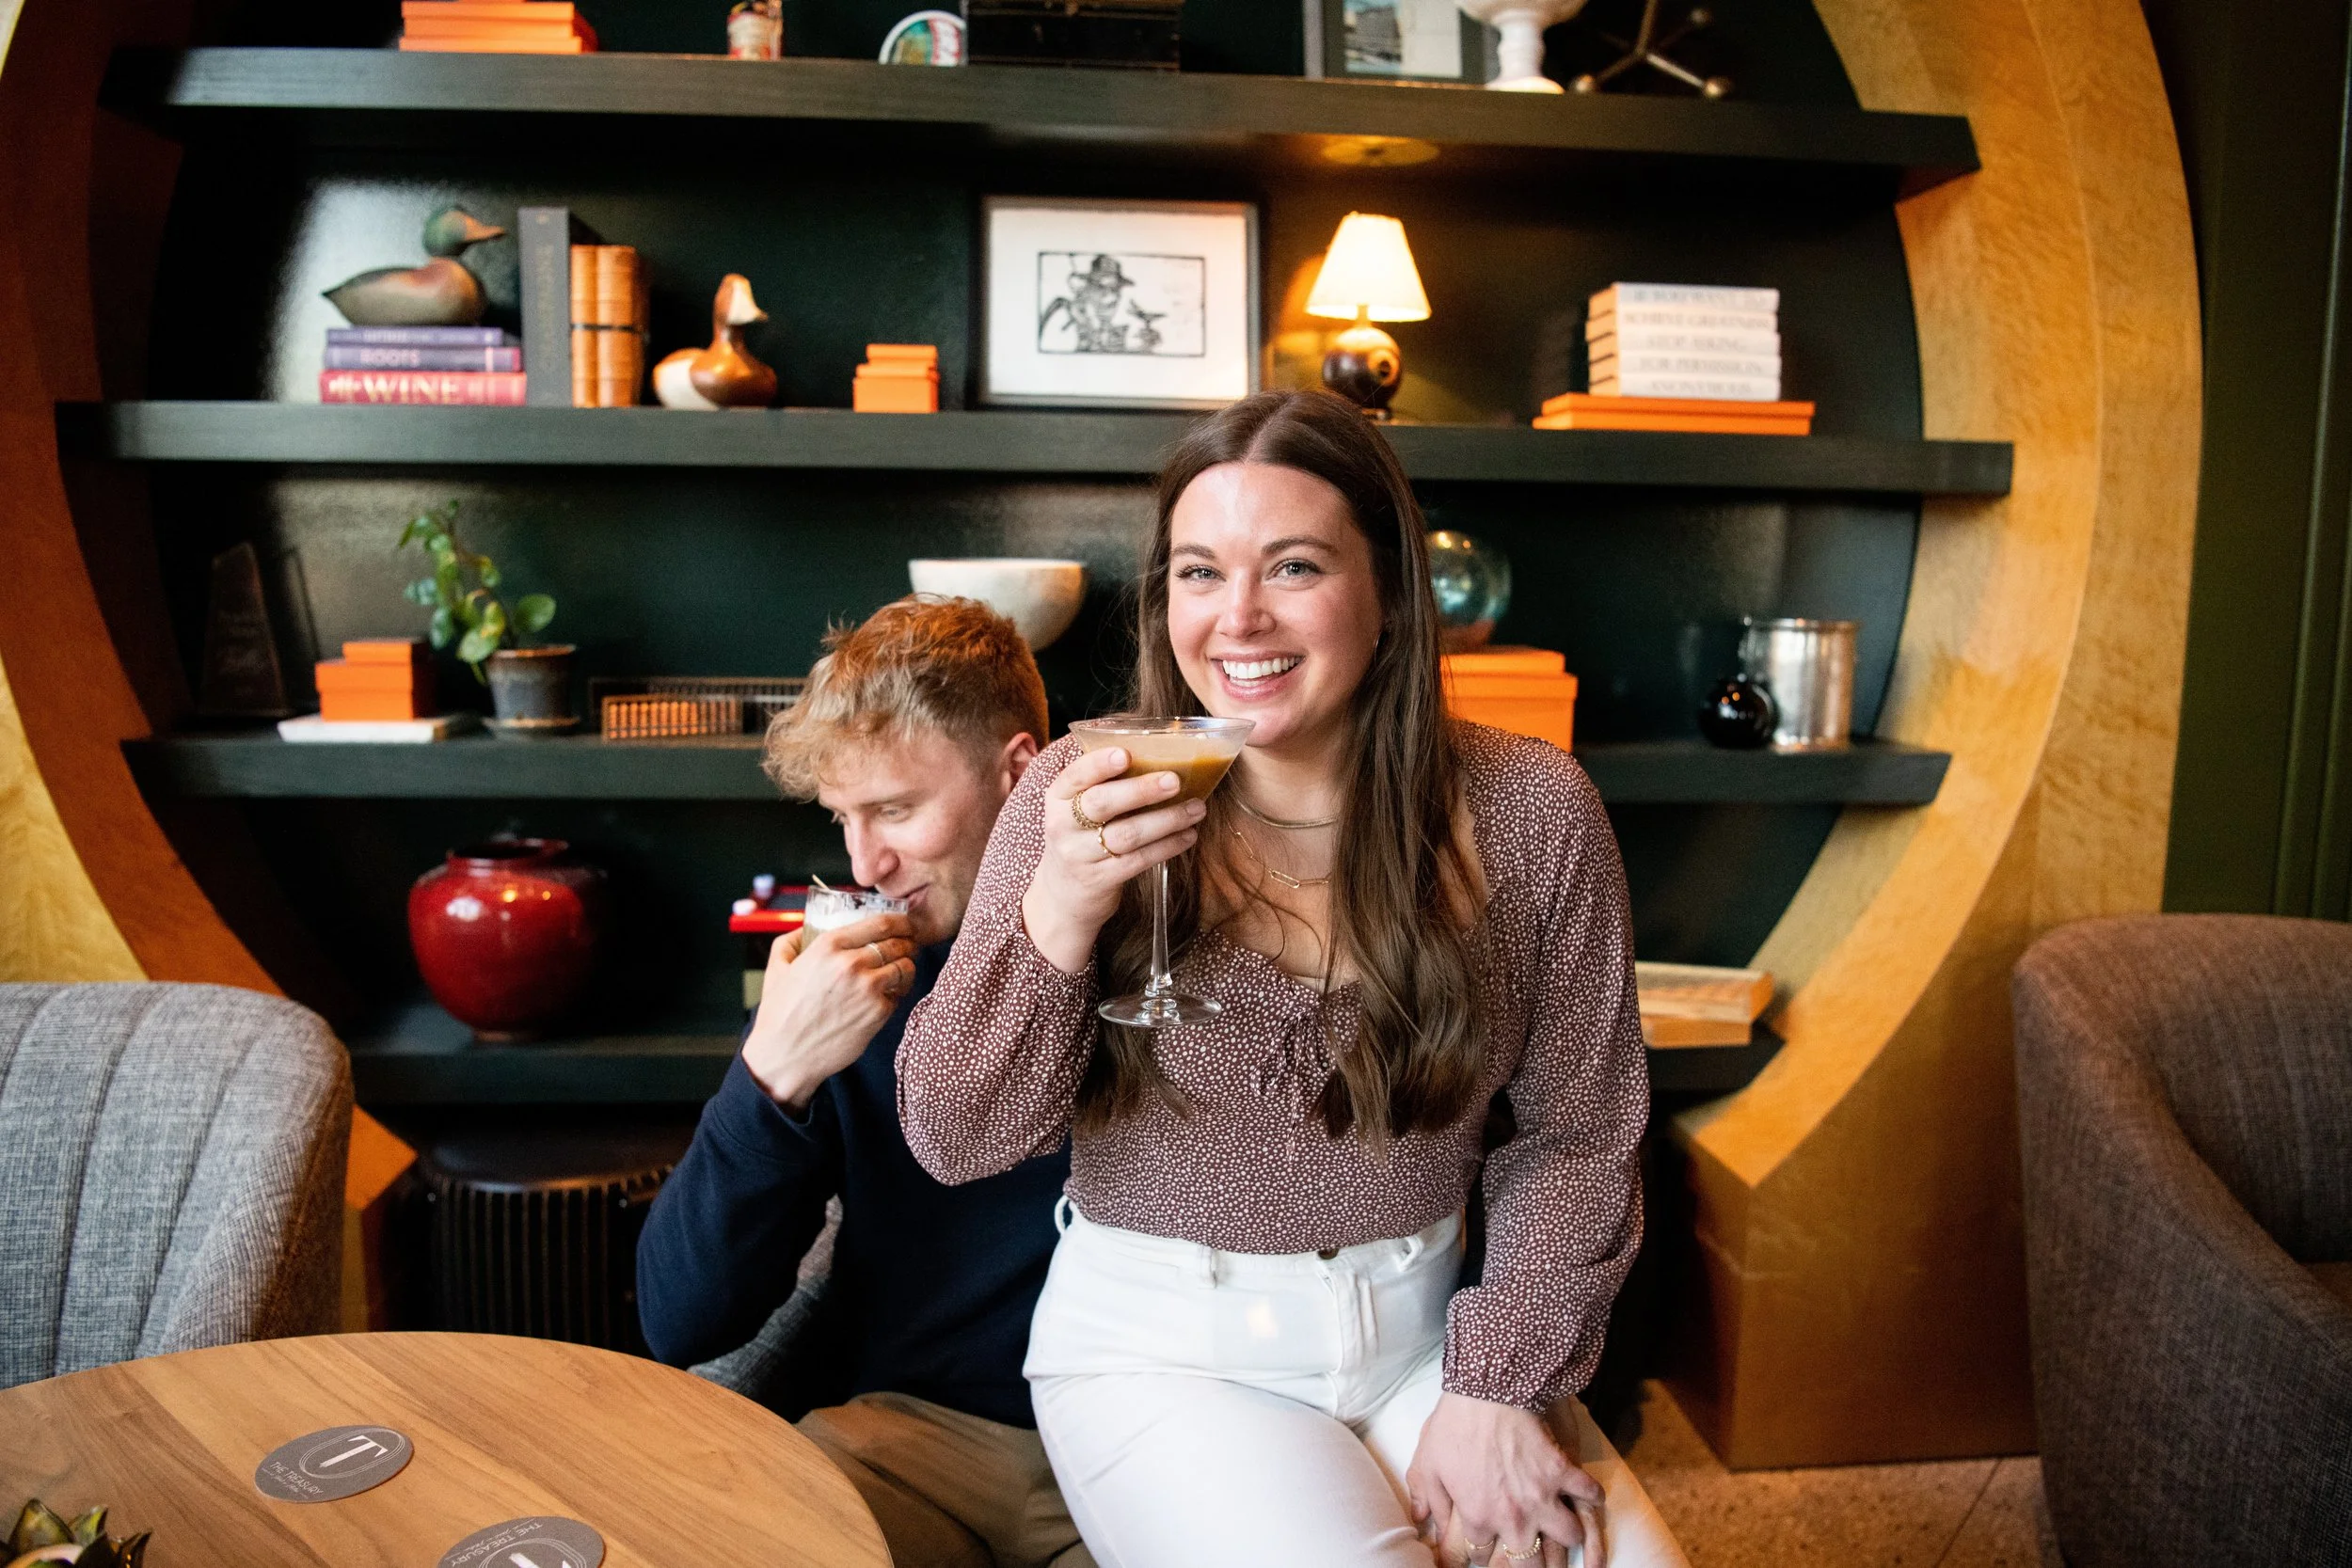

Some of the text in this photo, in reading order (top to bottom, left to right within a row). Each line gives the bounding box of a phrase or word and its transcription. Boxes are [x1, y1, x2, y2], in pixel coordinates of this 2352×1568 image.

[359, 349, 421, 368] ROOTS
[362, 375, 459, 403] WINE
[319, 1434, 389, 1468] T
[270, 1461, 290, 1474] THE
[284, 1470, 325, 1496] TREASURY
[516, 1521, 544, 1537] THE
[452, 1535, 516, 1568] TREASURY
